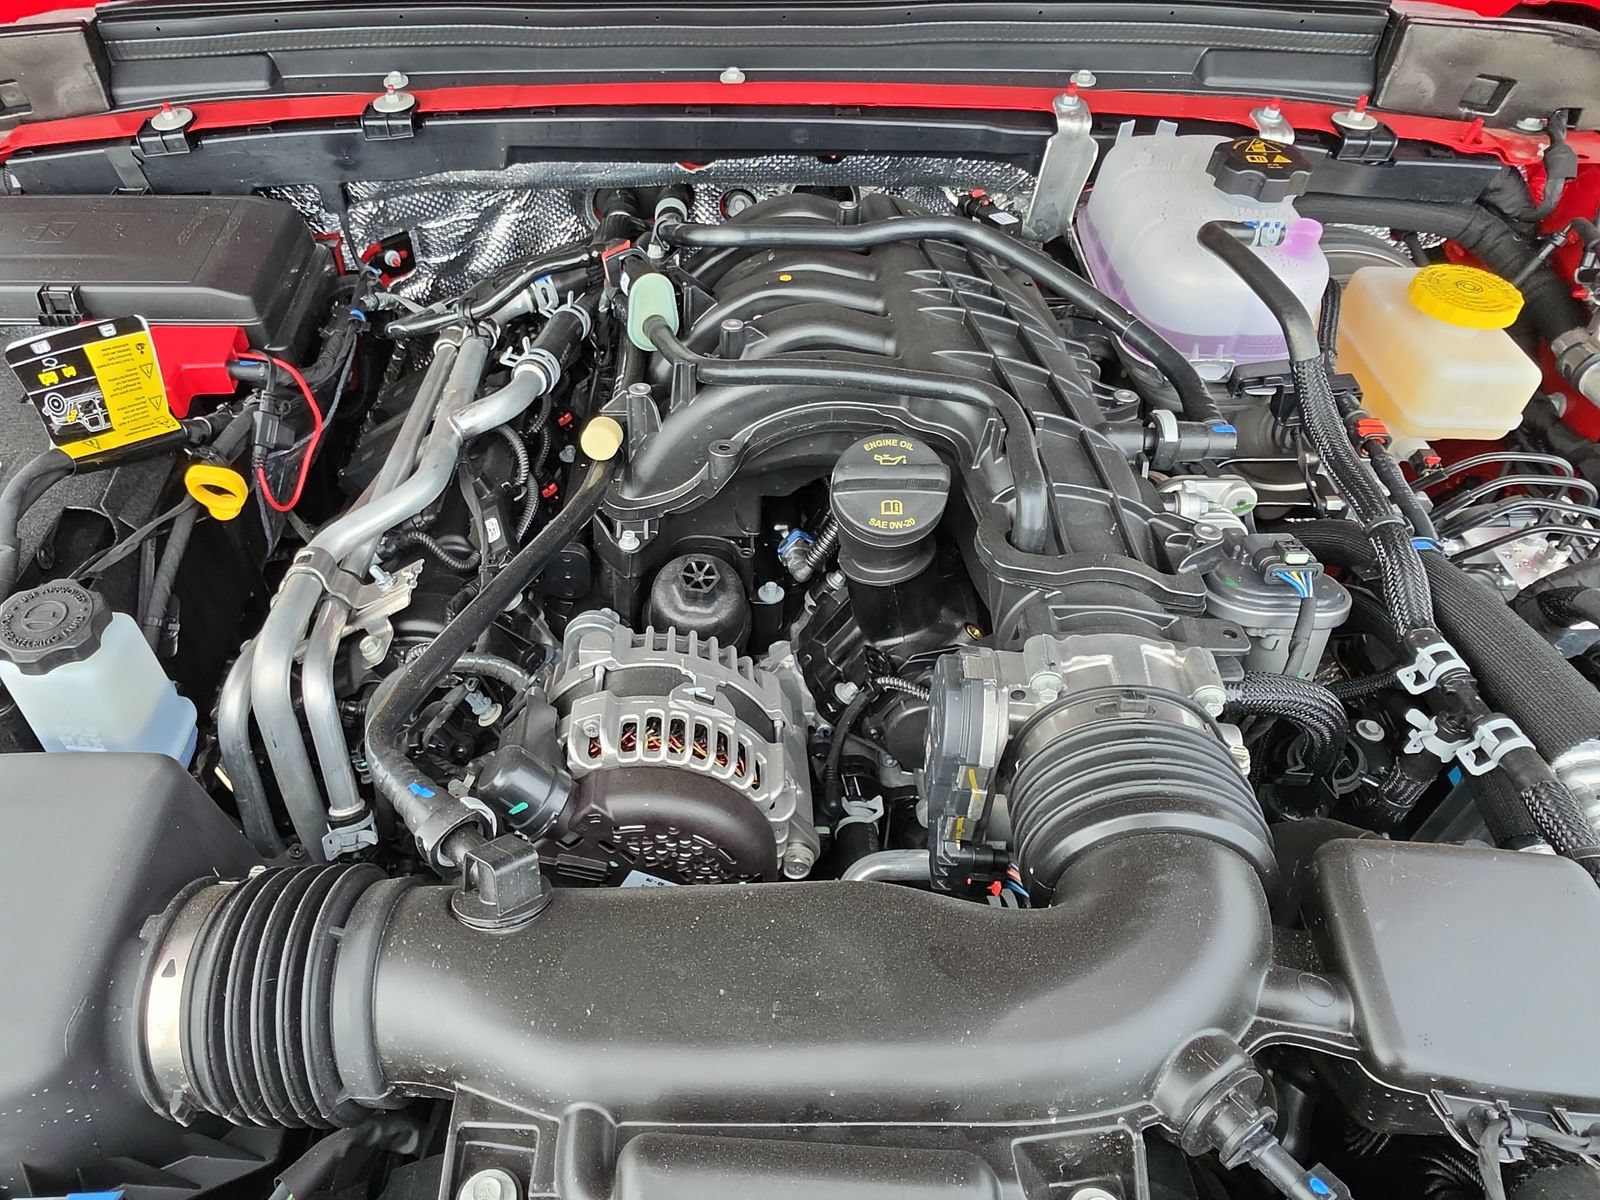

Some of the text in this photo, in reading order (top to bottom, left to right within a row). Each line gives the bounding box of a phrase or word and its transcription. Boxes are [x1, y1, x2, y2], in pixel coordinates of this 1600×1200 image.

[863, 439, 914, 451] ENGINE OIL
[868, 517, 916, 530] SAE 0W-20
[42, 586, 87, 603] APPROVED
